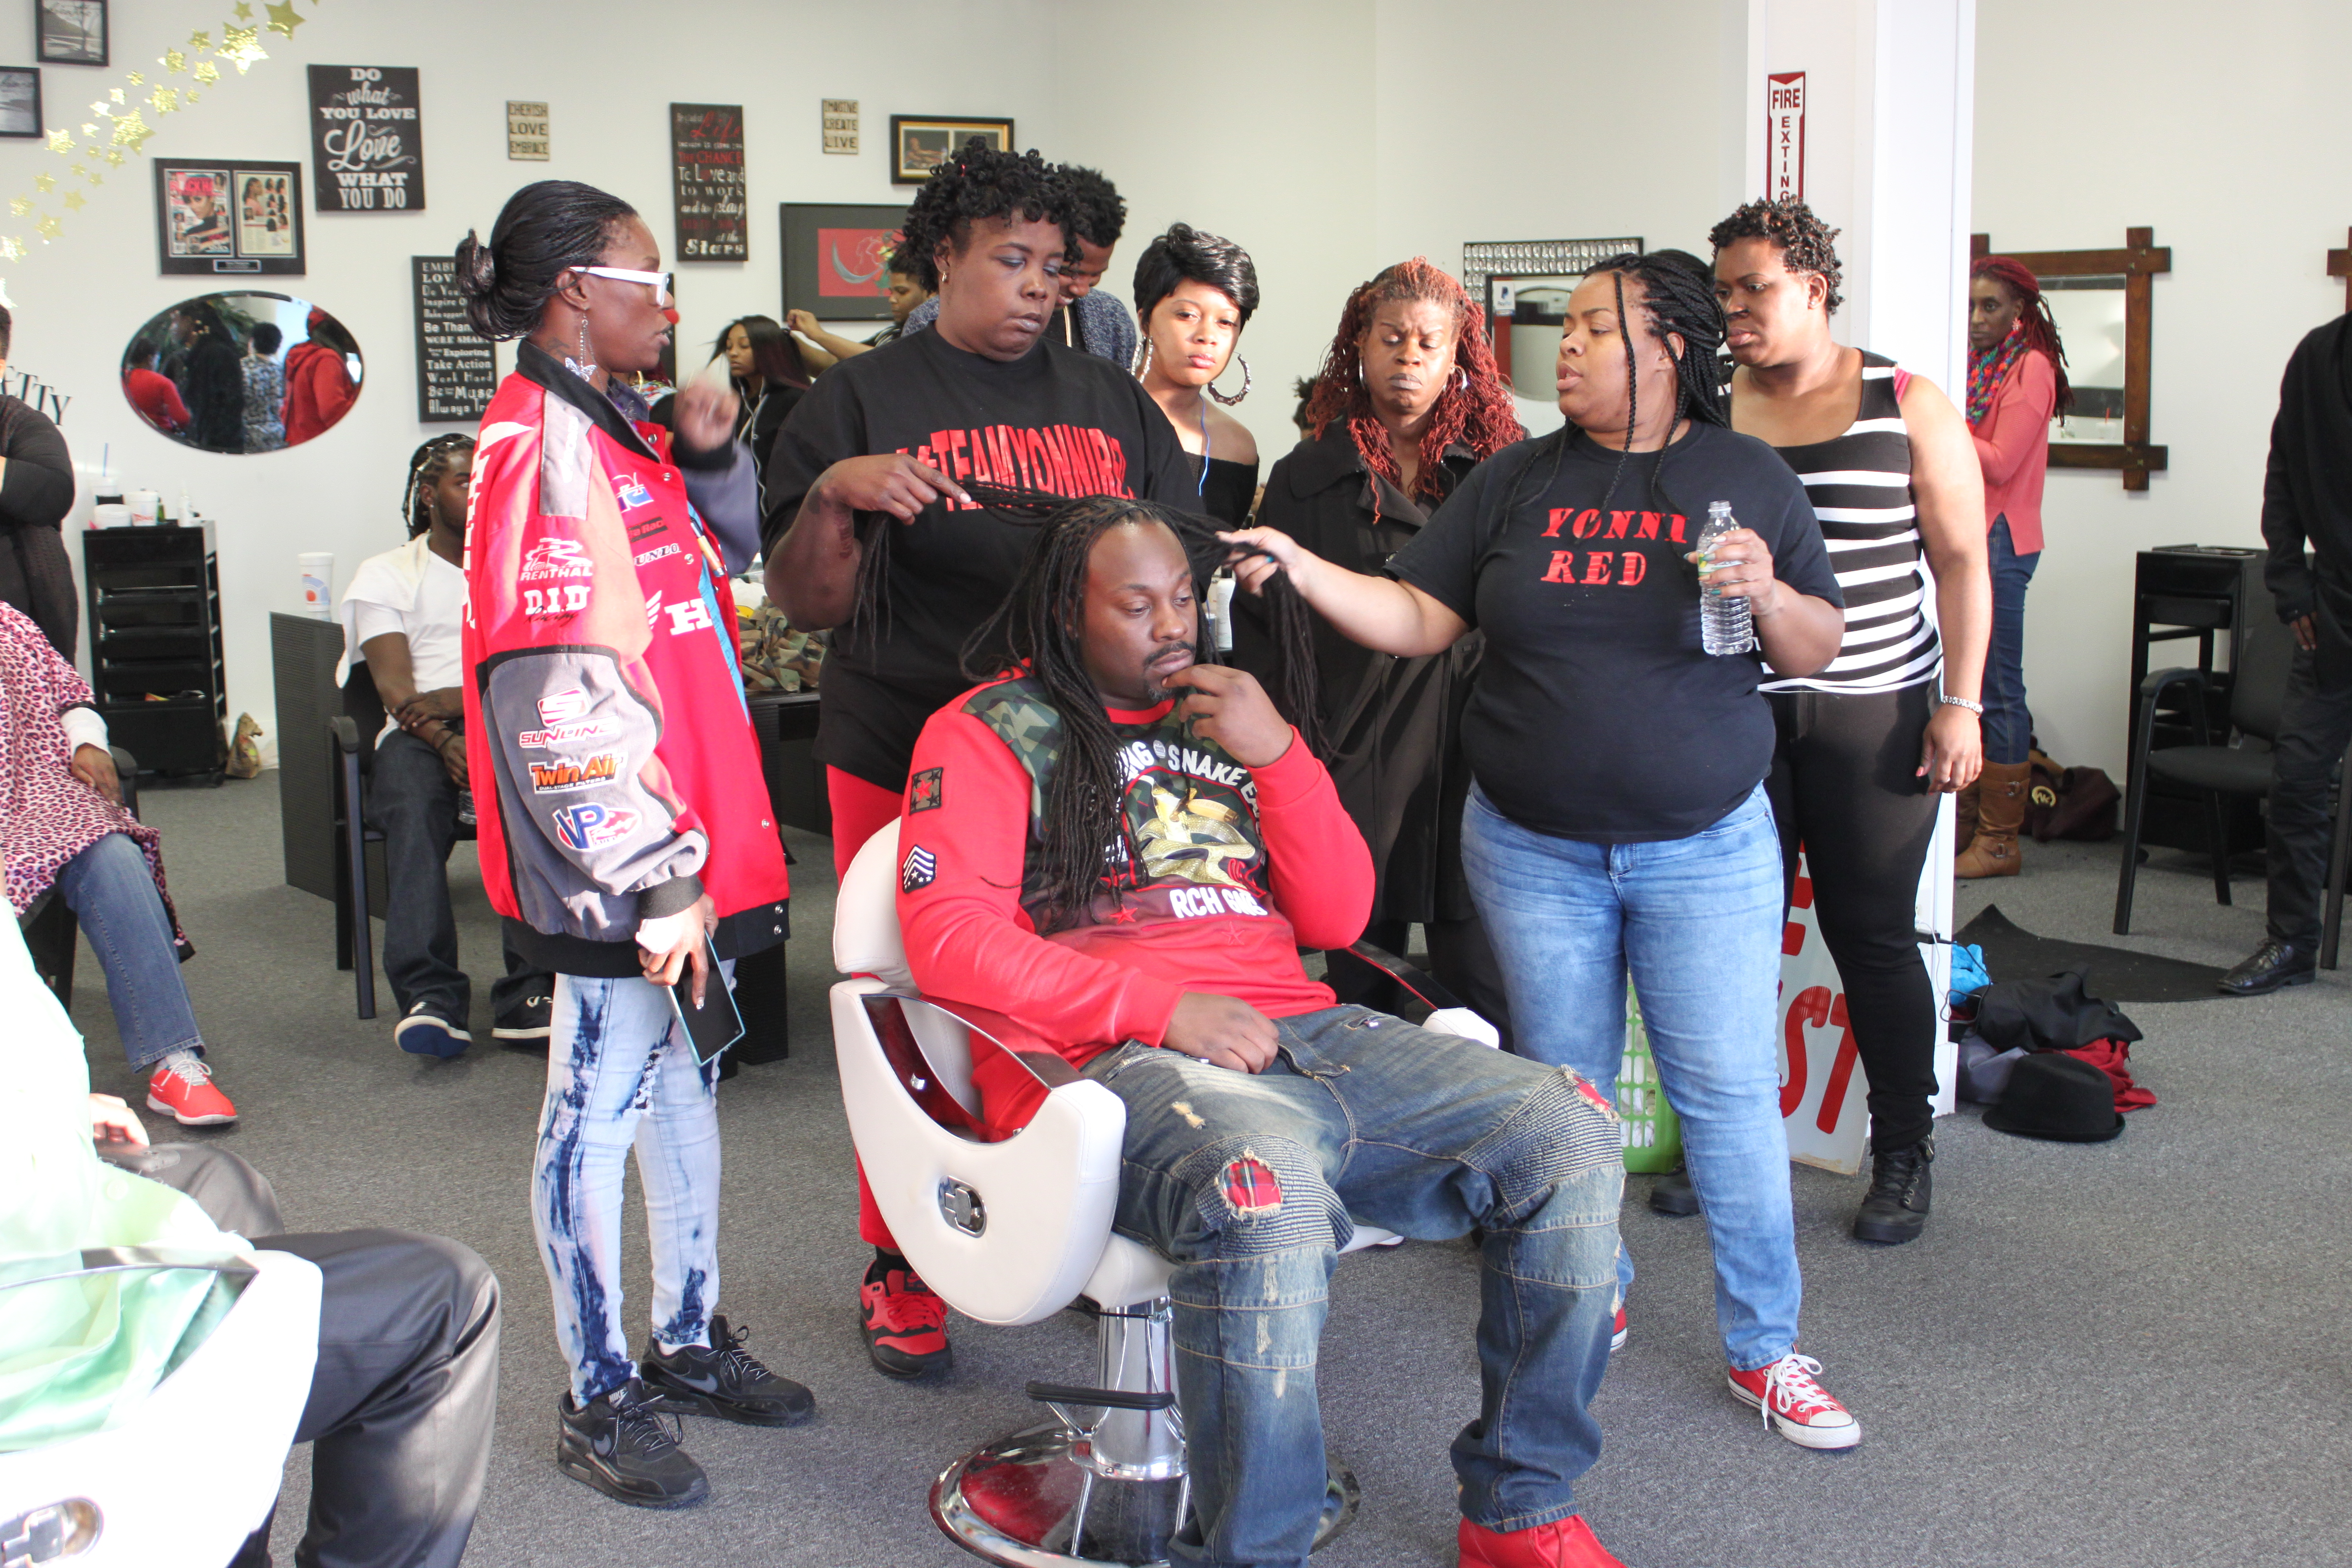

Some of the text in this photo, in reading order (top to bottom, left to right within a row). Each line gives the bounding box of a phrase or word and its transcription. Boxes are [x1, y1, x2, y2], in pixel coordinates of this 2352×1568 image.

[350, 68, 382, 81] DO
[347, 81, 391, 105] what
[1772, 88, 1800, 110] FIRE
[320, 107, 417, 120] YOU LOVE
[509, 122, 547, 135] LOVE
[324, 119, 402, 171] Love
[825, 136, 857, 147] LIVE
[697, 151, 742, 163] CHANCE
[336, 172, 408, 187] WHAT
[338, 187, 406, 209] YOU DO
[713, 195, 744, 220] play
[685, 239, 744, 255] Stars
[423, 323, 440, 333] Be
[443, 348, 490, 357] Exploring
[426, 359, 492, 369] Take Action
[427, 372, 493, 383] Work Hard
[429, 399, 470, 416] Always
[1541, 508, 1689, 543] YONNI
[520, 567, 593, 581] RENTHAL
[1541, 550, 1647, 586] RED
[531, 753, 624, 786] Twin Air
[1168, 744, 1247, 786] SNAKE
[555, 804, 605, 848] VP
[1170, 887, 1225, 918] RCH
